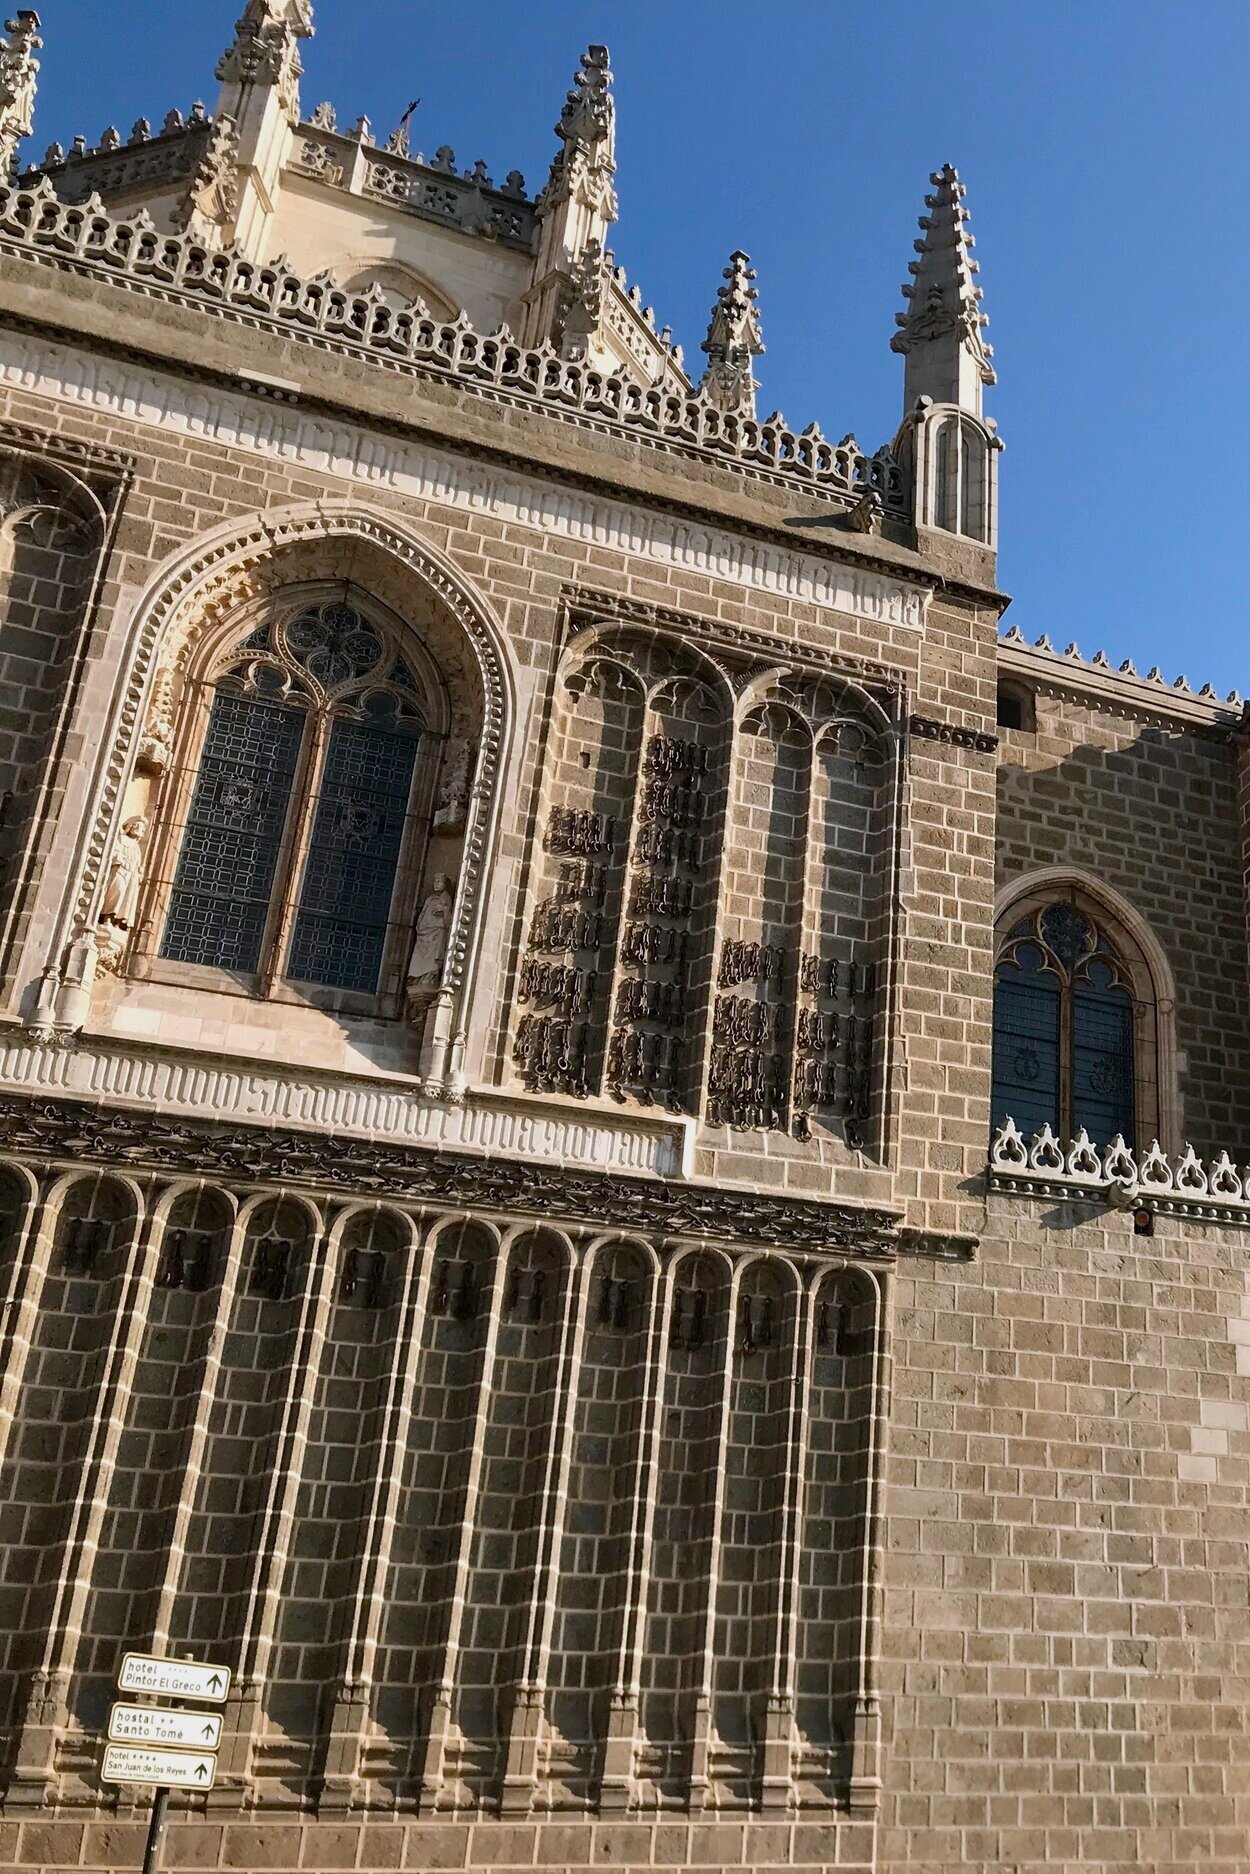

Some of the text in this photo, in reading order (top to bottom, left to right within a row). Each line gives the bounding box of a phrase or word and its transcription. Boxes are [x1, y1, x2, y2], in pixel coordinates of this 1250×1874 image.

[128, 1662, 157, 1674] hotel
[126, 1673, 201, 1692] Pintor El Greco
[117, 1711, 154, 1725] hostal
[116, 1723, 183, 1739] Santo Tomé
[109, 1751, 129, 1760] hotel
[108, 1761, 122, 1770] San
[124, 1762, 141, 1771] Juan
[143, 1764, 152, 1772] de
[154, 1765, 164, 1774] los
[166, 1766, 187, 1776] Reyes
